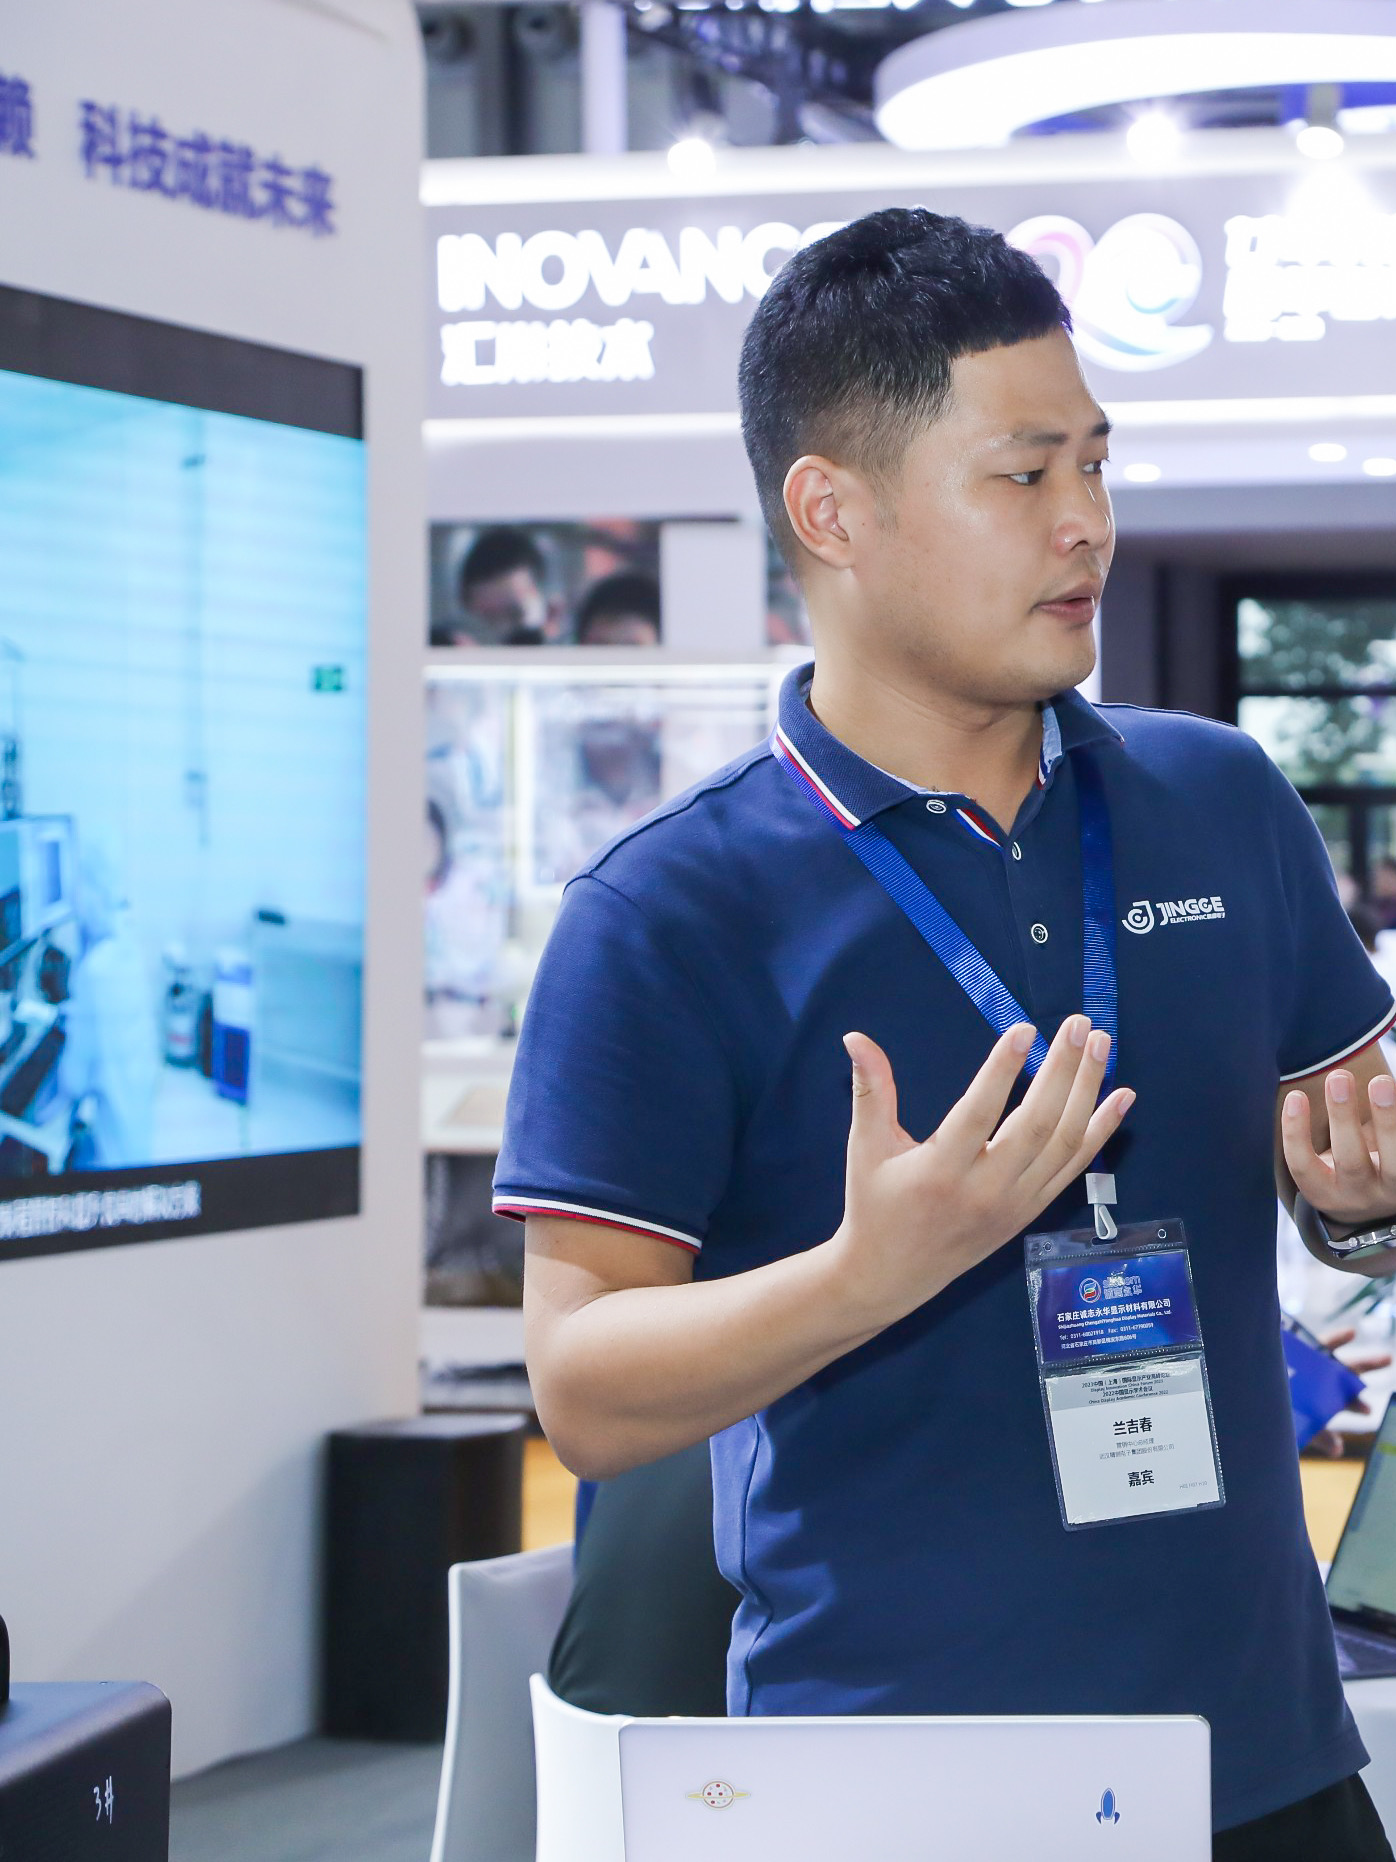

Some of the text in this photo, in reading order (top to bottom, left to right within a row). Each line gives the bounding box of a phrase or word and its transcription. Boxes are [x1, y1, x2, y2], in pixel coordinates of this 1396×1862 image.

[1057, 1298, 1171, 1322] 石家庄诚志永华显示材料有限公司
[1113, 1416, 1153, 1437] 兰吉春
[1127, 1469, 1155, 1488] 嘉宾
